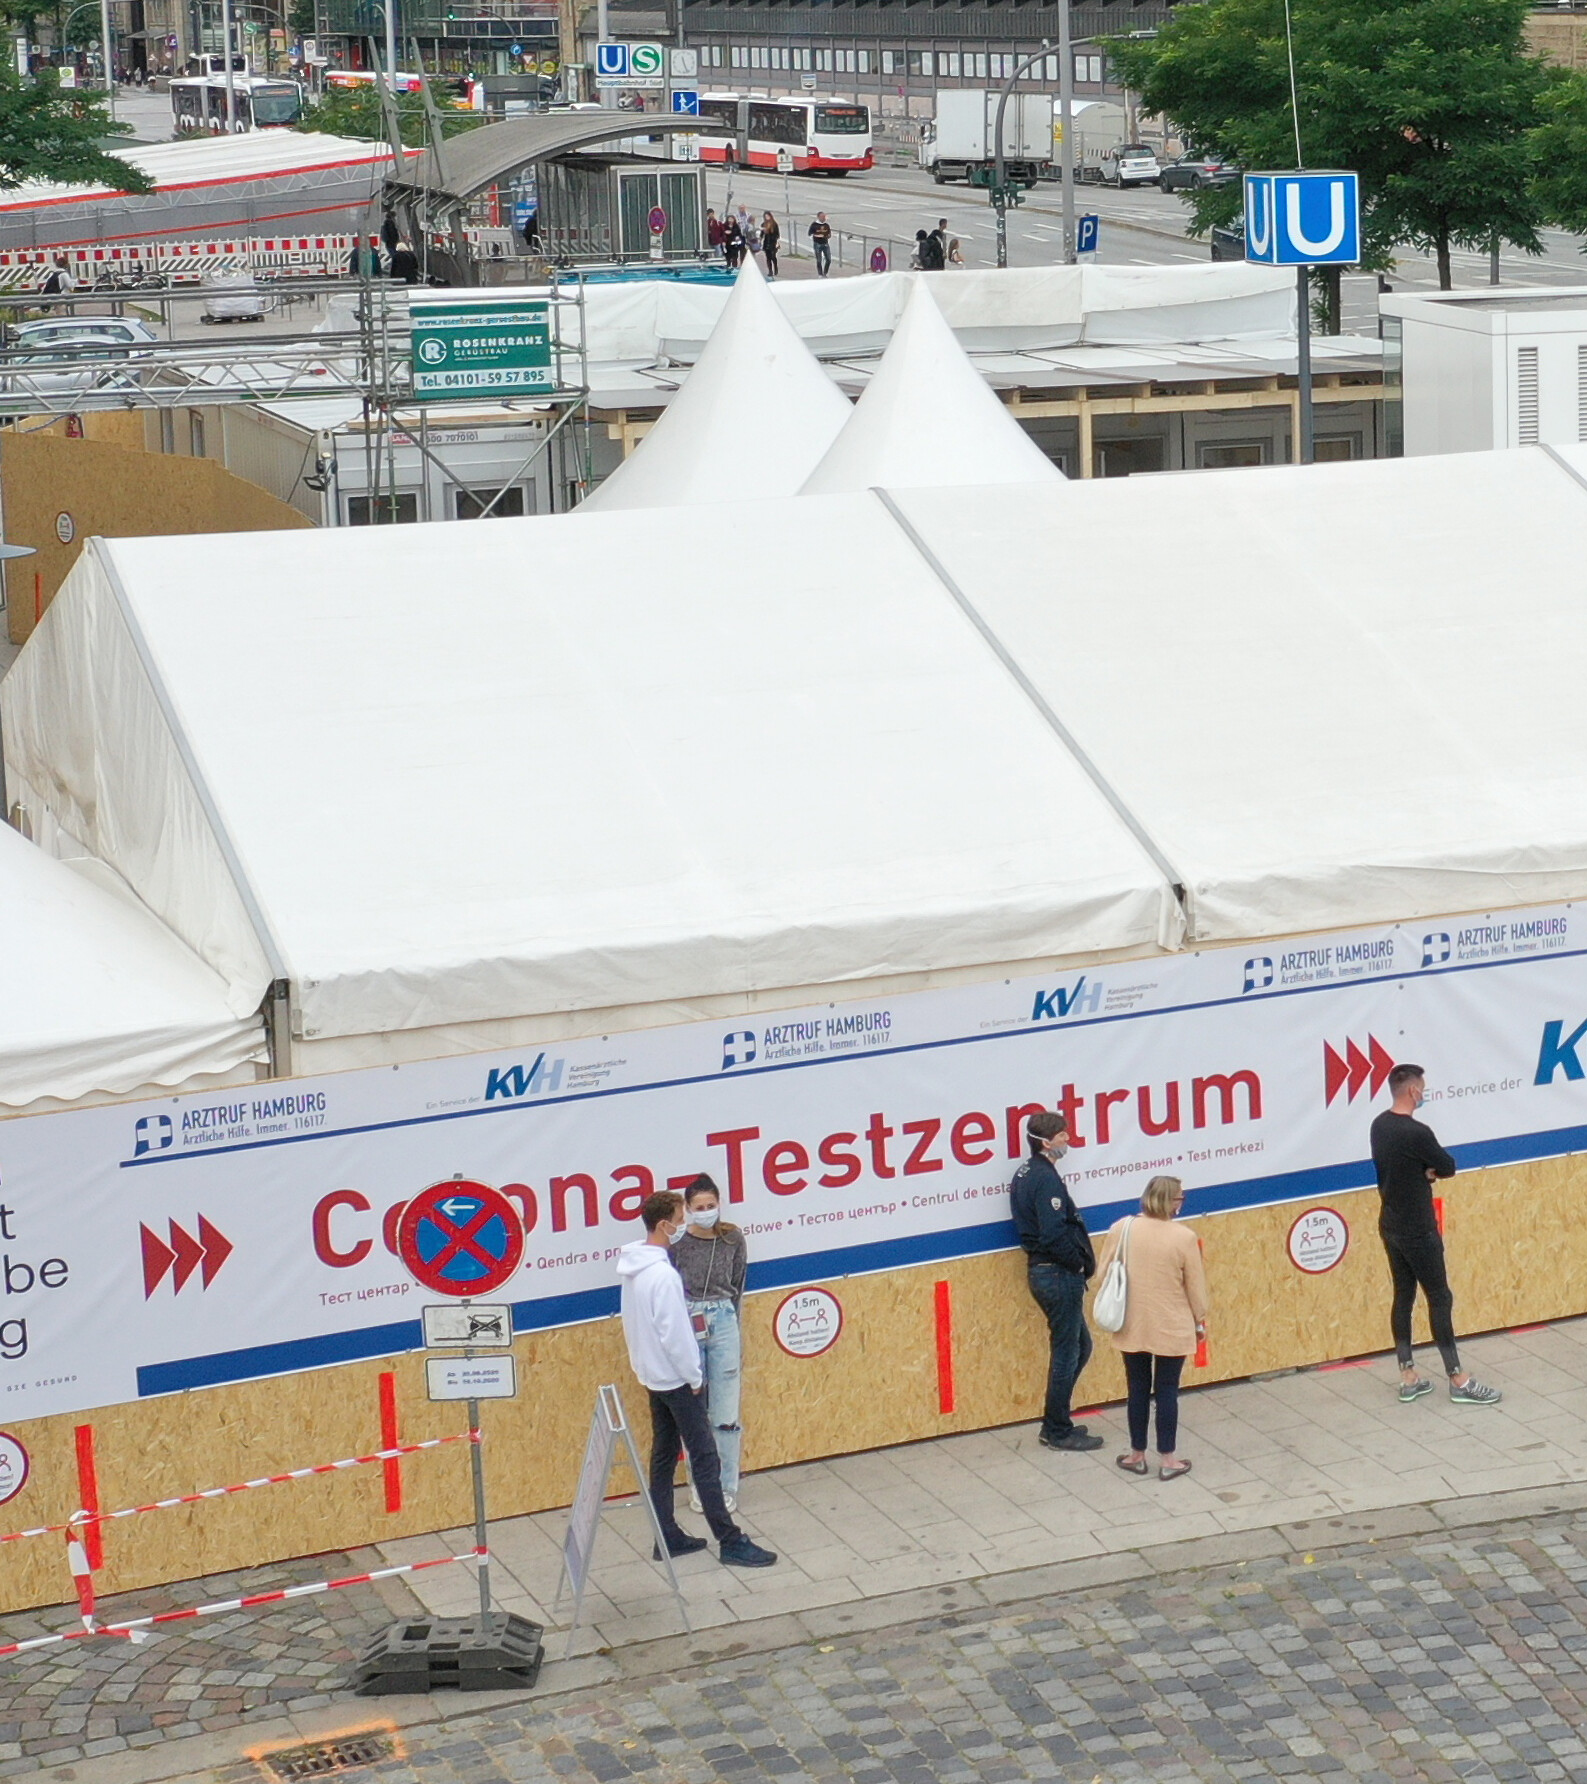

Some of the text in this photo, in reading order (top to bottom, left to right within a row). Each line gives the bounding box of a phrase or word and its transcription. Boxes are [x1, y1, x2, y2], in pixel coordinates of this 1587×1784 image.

[602, 47, 623, 72] U
[636, 47, 656, 72] S
[1082, 220, 1093, 248] P
[1248, 182, 1269, 255] U
[1286, 182, 1345, 256] U
[453, 335, 544, 348] ROSENKRANZ
[421, 375, 441, 388] Tel.
[505, 371, 520, 383] 57
[523, 370, 545, 382] 895
[1457, 917, 1567, 948] ARZTRUF HAMBURG
[1280, 939, 1394, 972] ARZTRUF HAMBURG
[1031, 975, 1103, 1021] KVH
[764, 1010, 892, 1047] ARZTRUF HAMBURG
[484, 1051, 566, 1101] KVH
[1422, 1076, 1524, 1103] Ein Service der
[181, 1091, 327, 1131] ARZTRUF HAMBURG
[183, 1131, 225, 1146] Ärztliche
[256, 1122, 291, 1135] Immer.
[319, 1290, 353, 1307] Тест
[357, 1280, 410, 1302] центар
[536, 1252, 588, 1271] Qendra
[592, 1252, 600, 1262] e
[798, 1210, 845, 1227] Тестов
[848, 1202, 897, 1220] център
[911, 1189, 959, 1209] Centrul
[963, 1186, 979, 1200] de
[1085, 1156, 1173, 1180] тестирования
[1187, 1148, 1212, 1163] Test
[1215, 1139, 1265, 1158] merkezi
